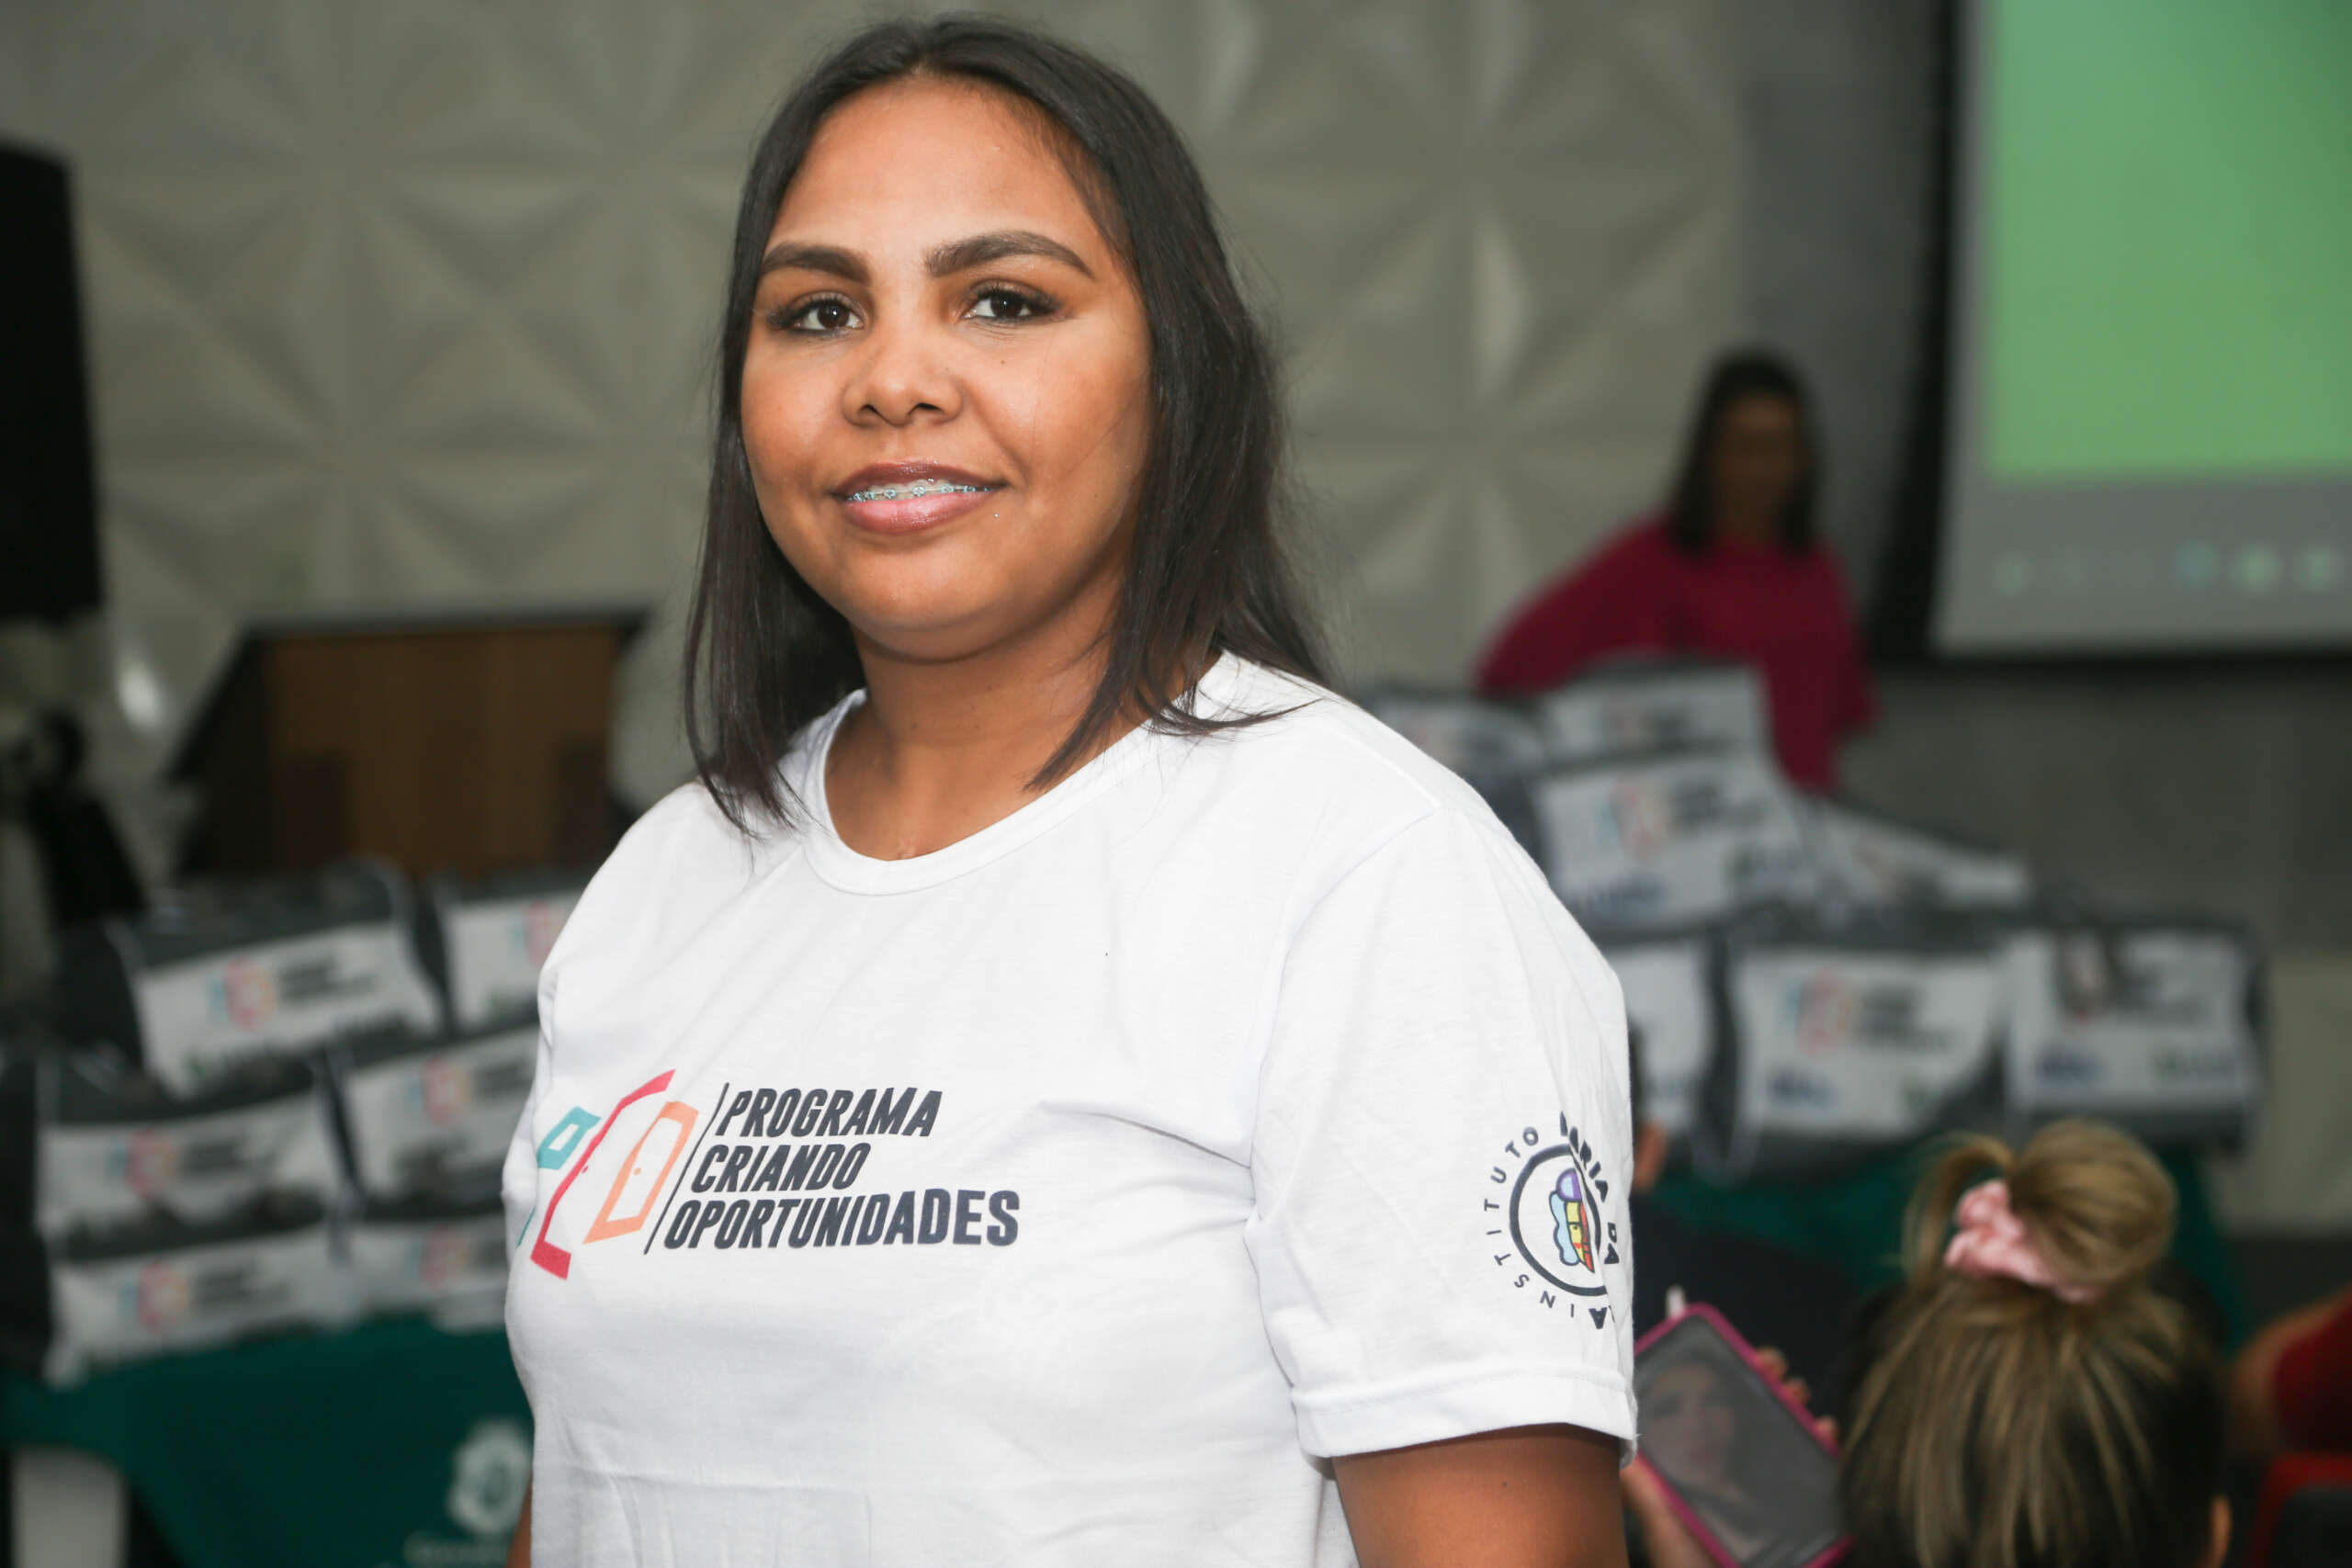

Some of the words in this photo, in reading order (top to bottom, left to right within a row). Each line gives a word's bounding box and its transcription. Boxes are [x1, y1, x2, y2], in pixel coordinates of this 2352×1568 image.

[715, 1087, 943, 1137] PROGRAMA
[691, 1142, 871, 1193] CRIANDO
[663, 1188, 1020, 1249] OPORTUNIDADES
[1484, 1126, 1575, 1318] INSTITUTO
